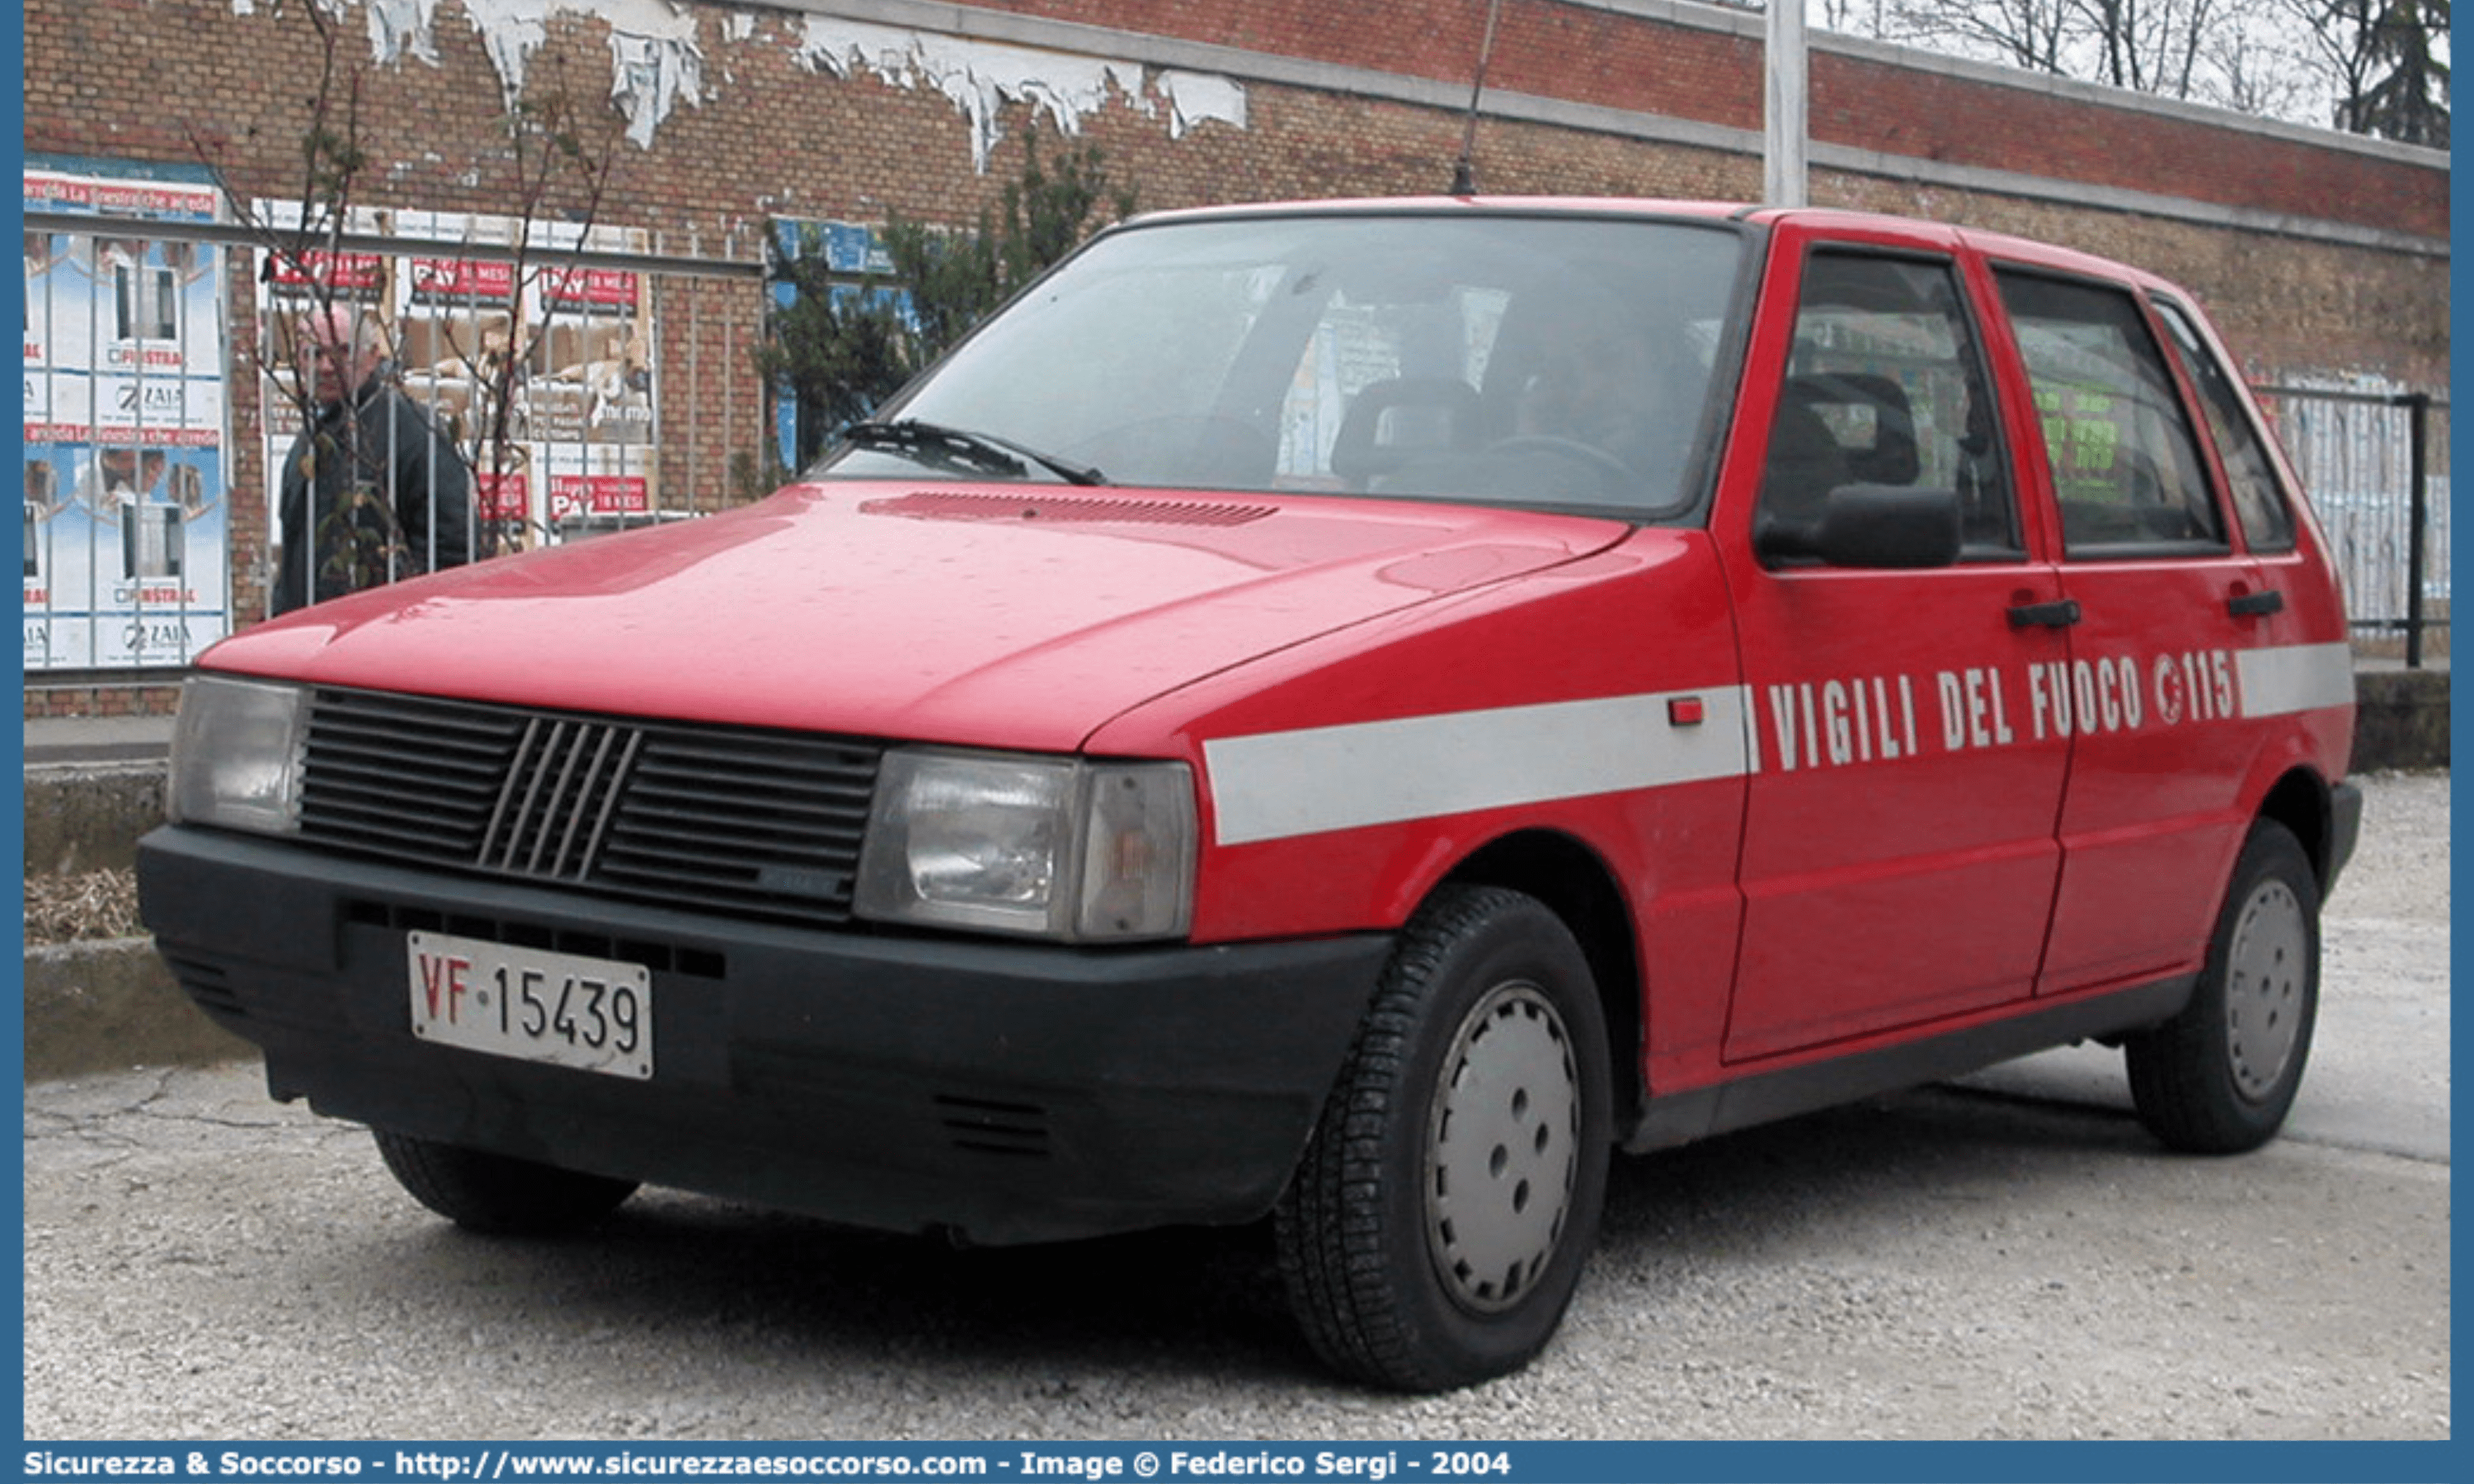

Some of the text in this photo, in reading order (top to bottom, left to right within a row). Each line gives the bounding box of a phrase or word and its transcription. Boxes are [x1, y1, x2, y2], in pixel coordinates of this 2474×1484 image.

[121, 348, 187, 365] FISTRA
[125, 588, 198, 603] FNSTRL
[1769, 648, 2234, 771] VIGILI DEL FUOCO 115
[418, 953, 638, 1054] VF 15439
